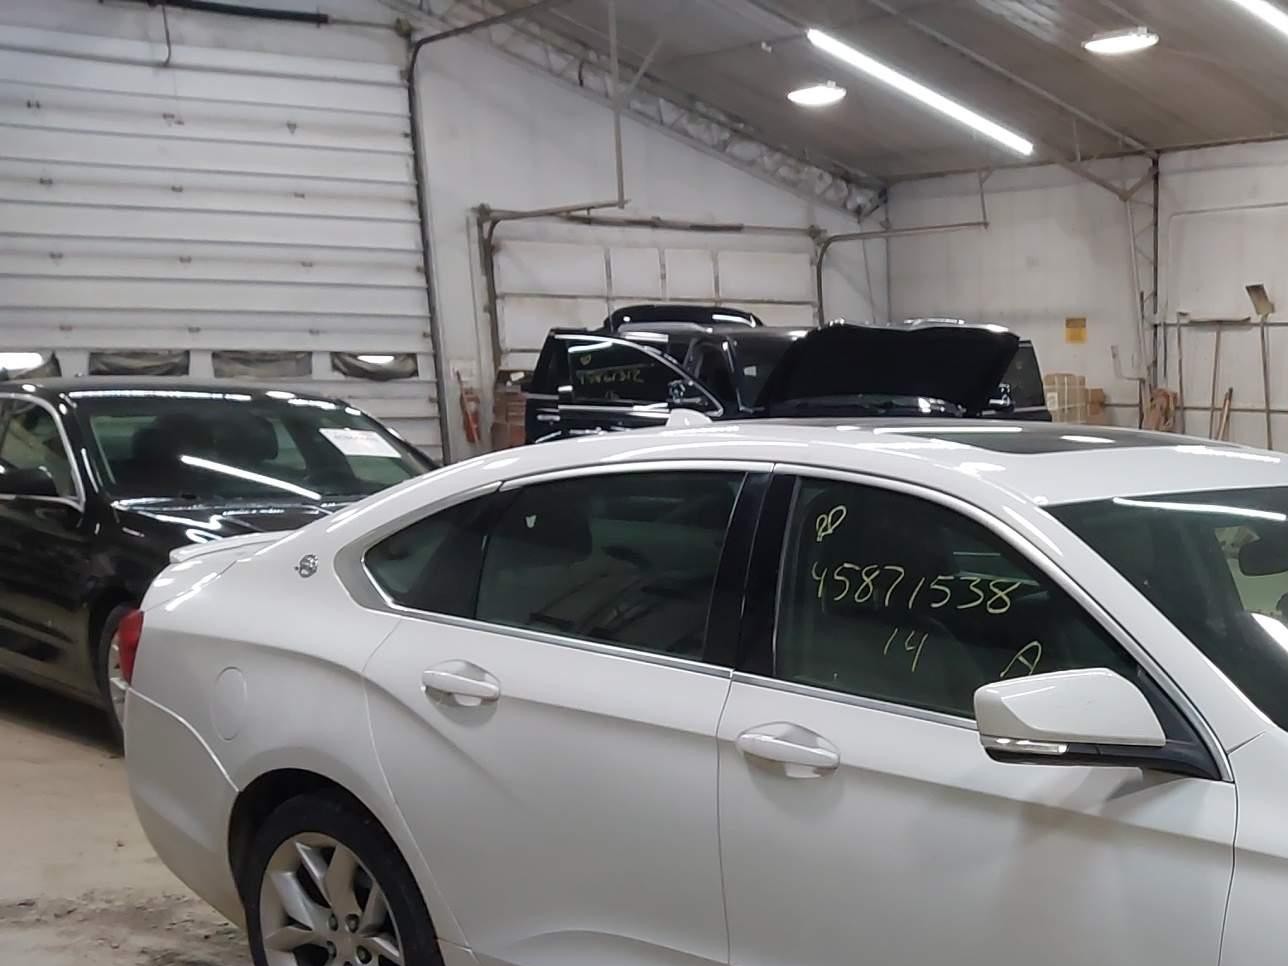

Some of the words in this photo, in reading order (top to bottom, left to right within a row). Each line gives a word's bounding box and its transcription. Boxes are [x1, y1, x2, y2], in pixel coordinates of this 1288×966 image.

[812, 561, 1021, 614] 45871538
[883, 627, 929, 672] 14
[1000, 640, 1041, 678] A
